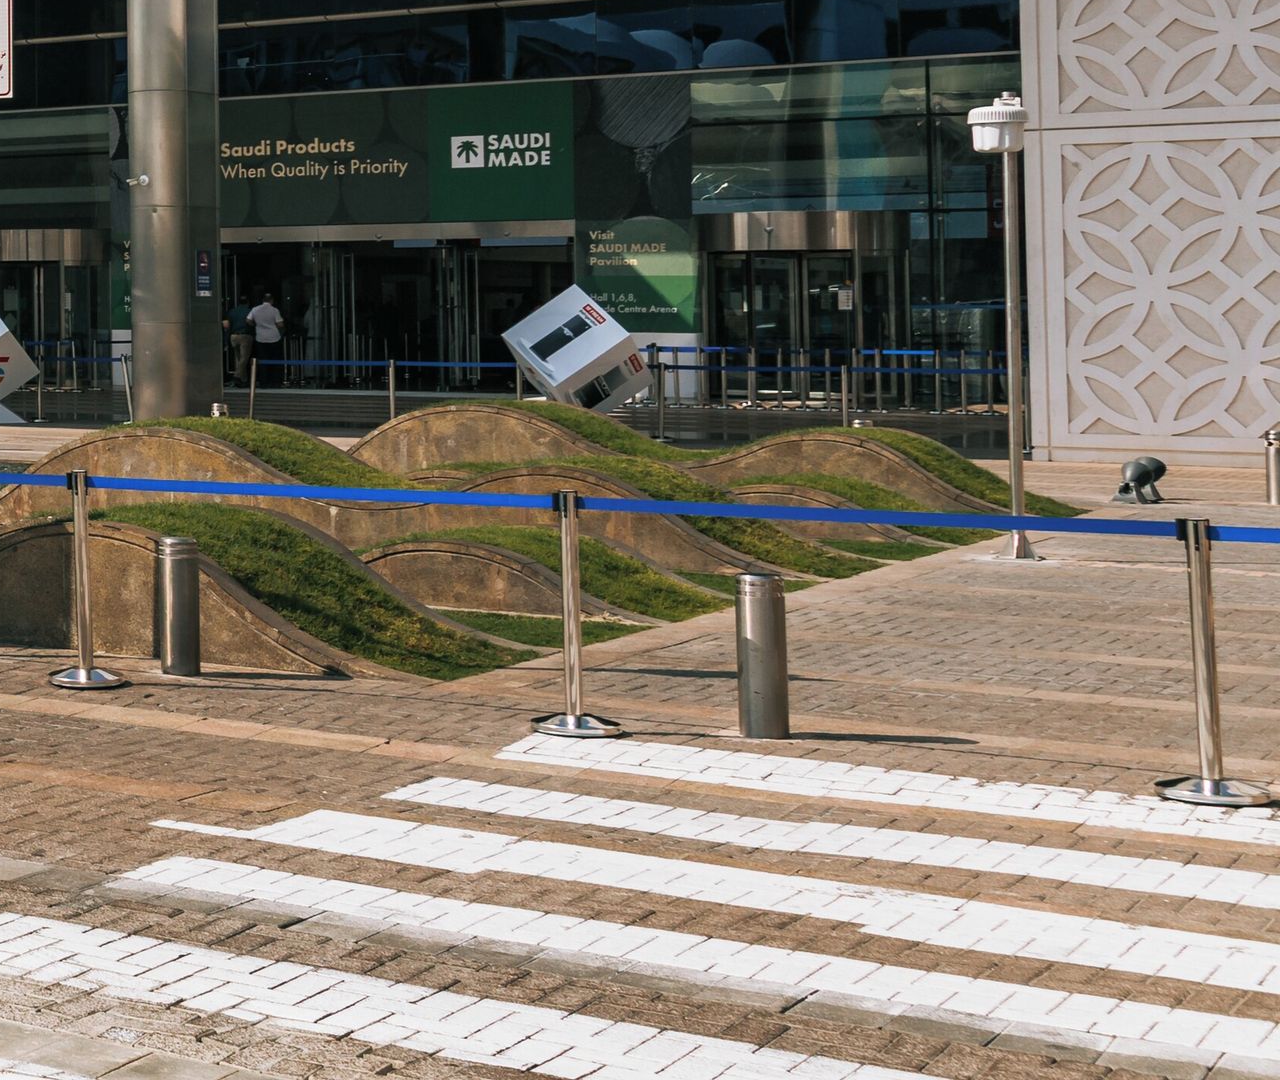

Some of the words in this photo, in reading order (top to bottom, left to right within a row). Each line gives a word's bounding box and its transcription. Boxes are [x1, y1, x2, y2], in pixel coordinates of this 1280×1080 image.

[220, 140, 271, 158] Saudi
[276, 137, 356, 155] Products
[487, 132, 551, 150] SAUDI
[487, 150, 551, 168] MADE
[220, 163, 266, 179] When
[271, 160, 329, 180] Quality
[333, 161, 346, 175] is
[350, 158, 408, 178] Priority
[589, 230, 615, 240] Visit
[589, 243, 627, 253] SAUDI
[630, 242, 667, 253] MADE
[589, 257, 638, 266] Pavilion
[617, 304, 647, 313] Centre
[649, 304, 678, 313] Arena
